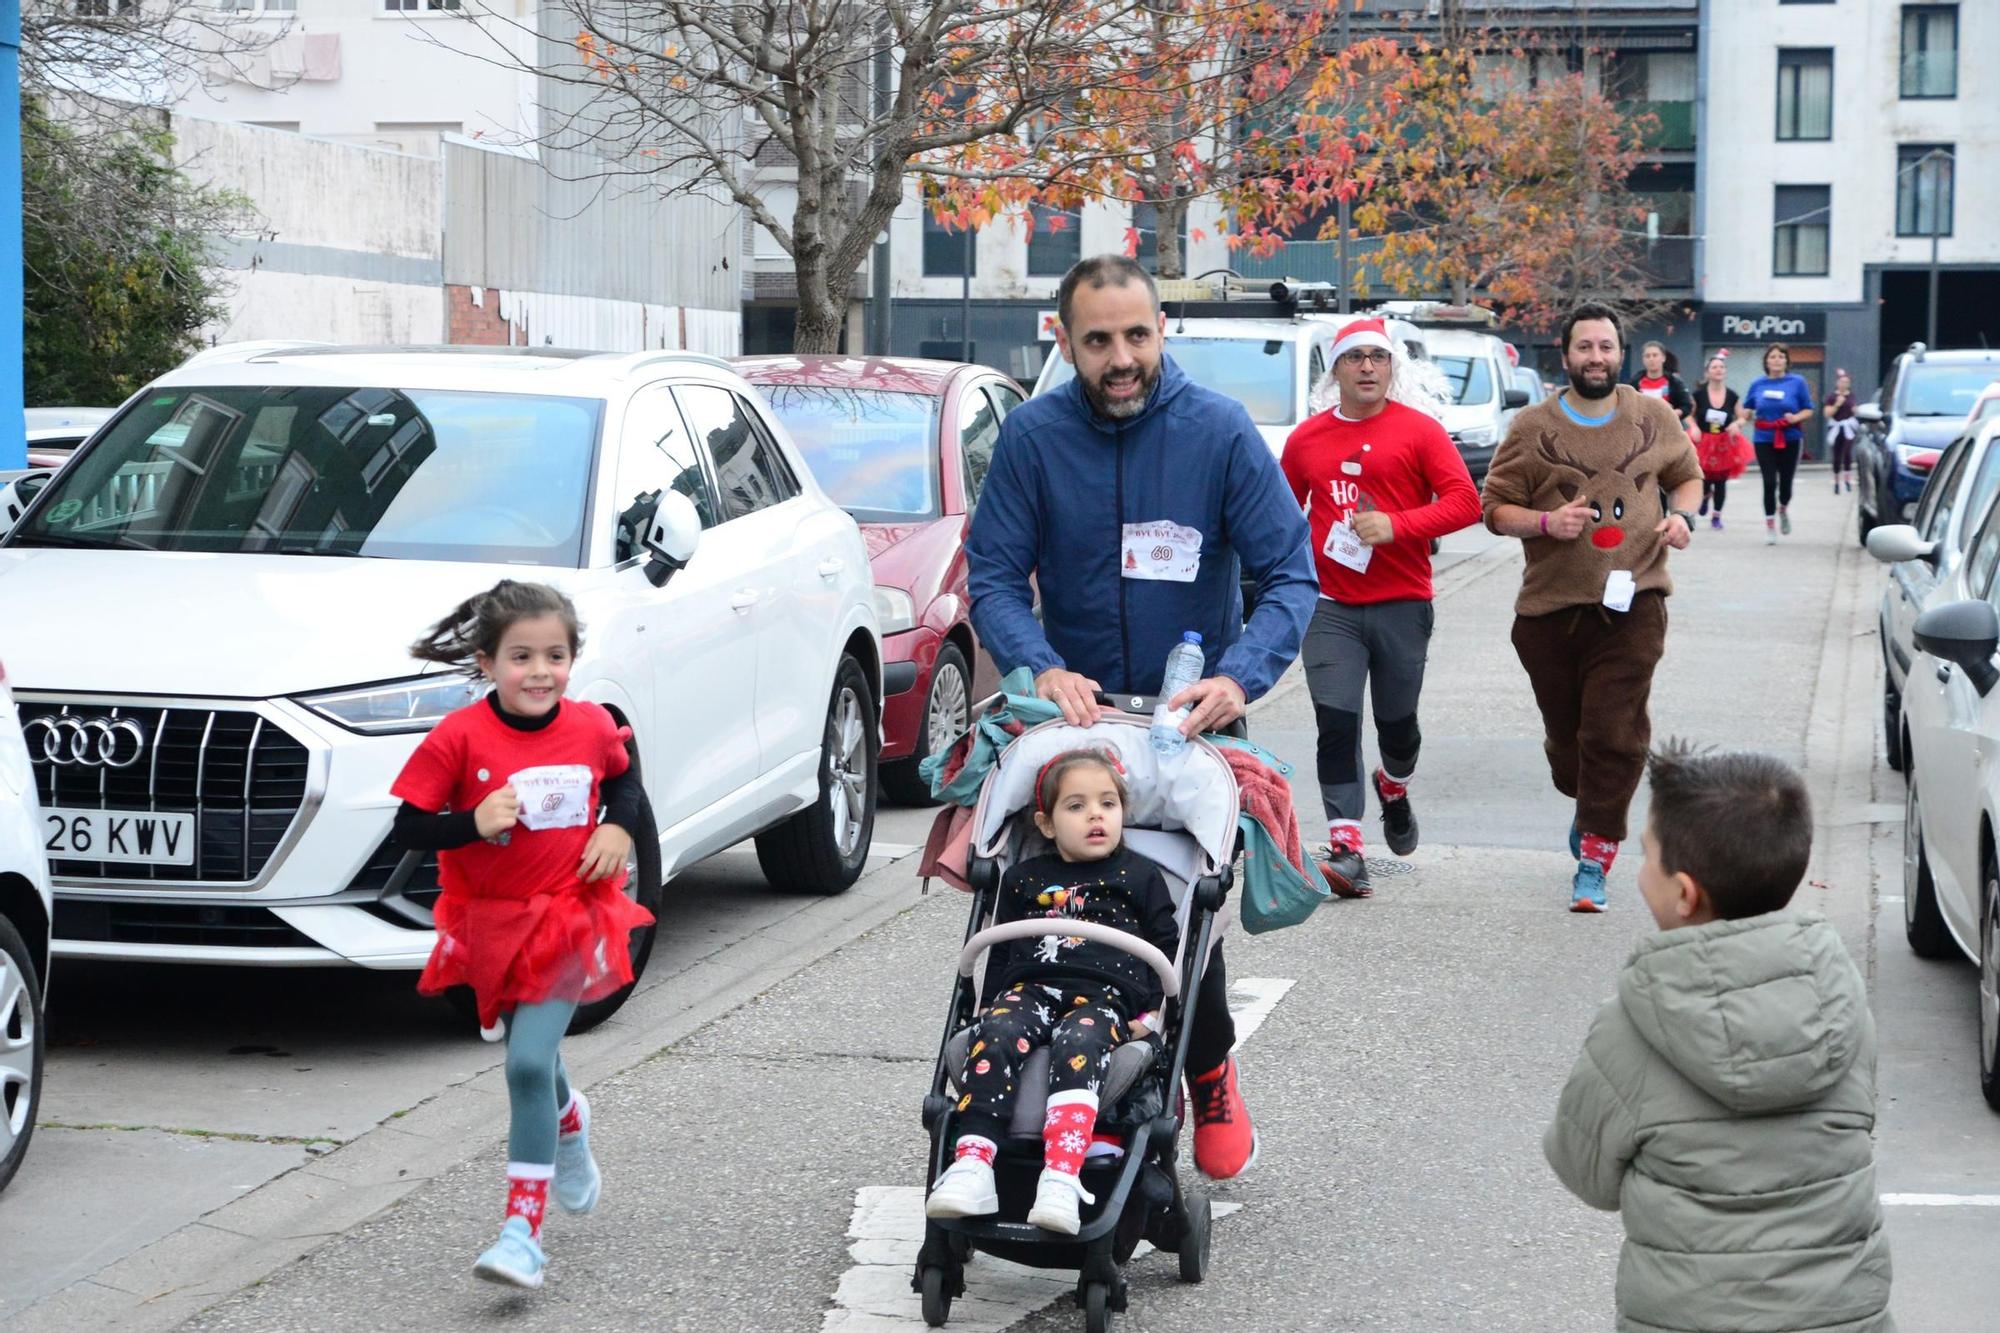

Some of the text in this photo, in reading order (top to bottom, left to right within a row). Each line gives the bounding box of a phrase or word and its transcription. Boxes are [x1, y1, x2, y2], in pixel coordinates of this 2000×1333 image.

[1722, 315, 1805, 339] PlayPlan
[1329, 480, 1359, 505] HO
[1151, 545, 1173, 561] 60
[541, 793, 565, 812] 67
[46, 815, 183, 857] 26 KWV
